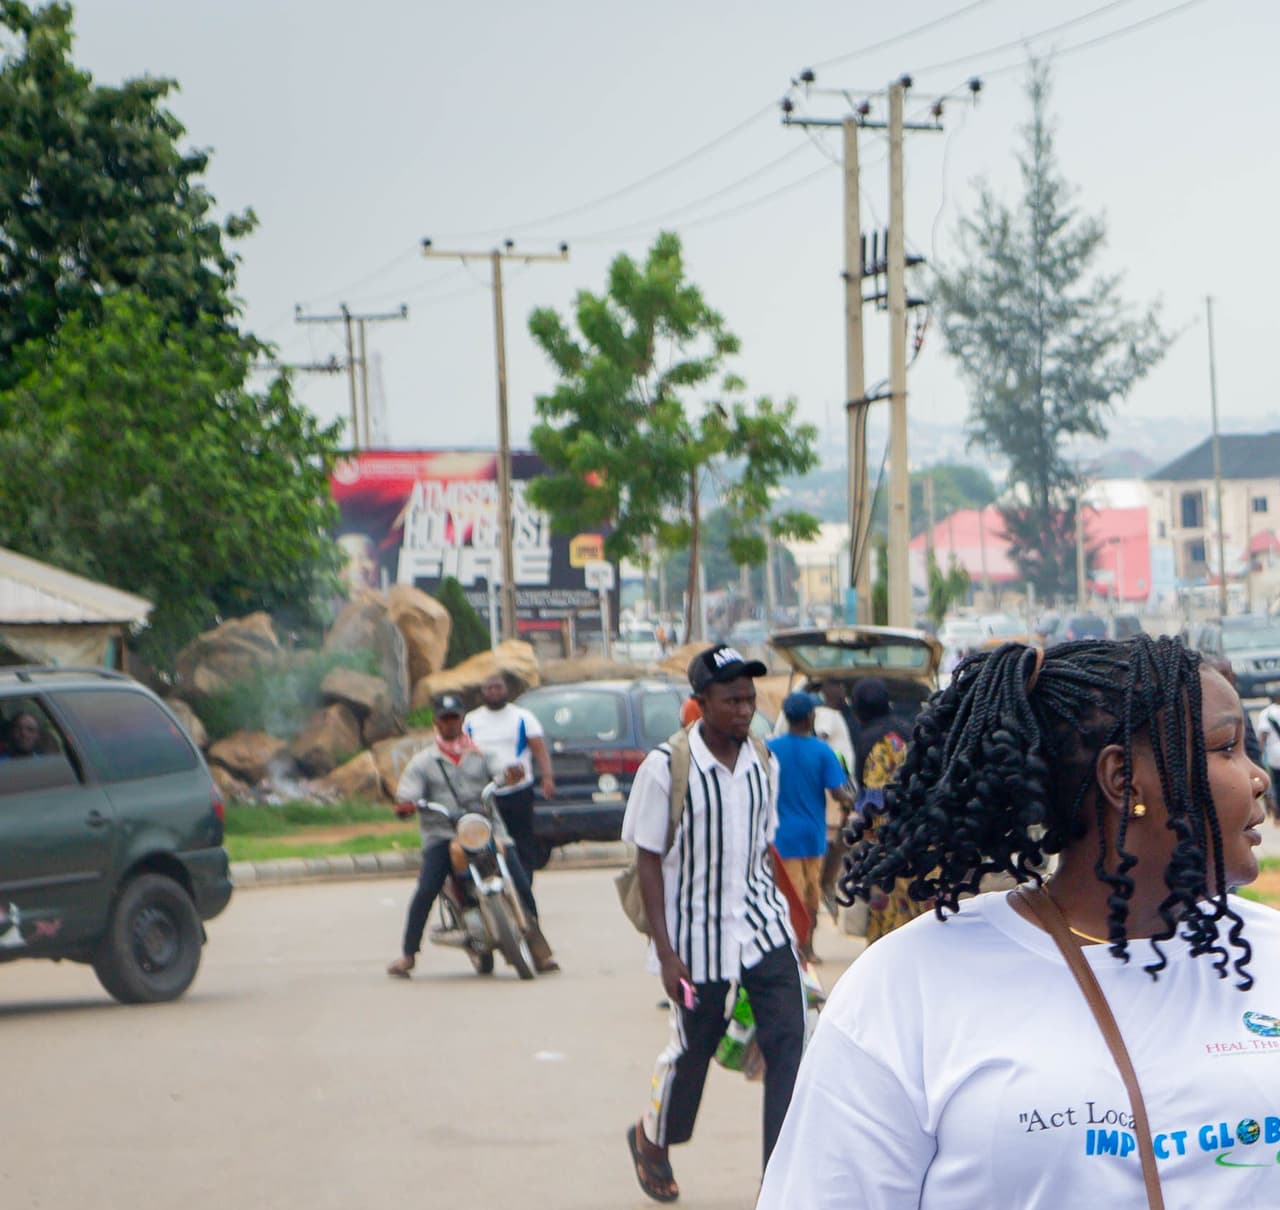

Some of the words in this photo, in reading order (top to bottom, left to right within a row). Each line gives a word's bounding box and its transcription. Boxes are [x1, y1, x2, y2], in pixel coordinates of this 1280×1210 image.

[1206, 1042, 1247, 1054] HEAL
[1250, 1039, 1280, 1050] THE
[1085, 1101, 1138, 1130] Loca
[1086, 1129, 1188, 1160] IMPCT
